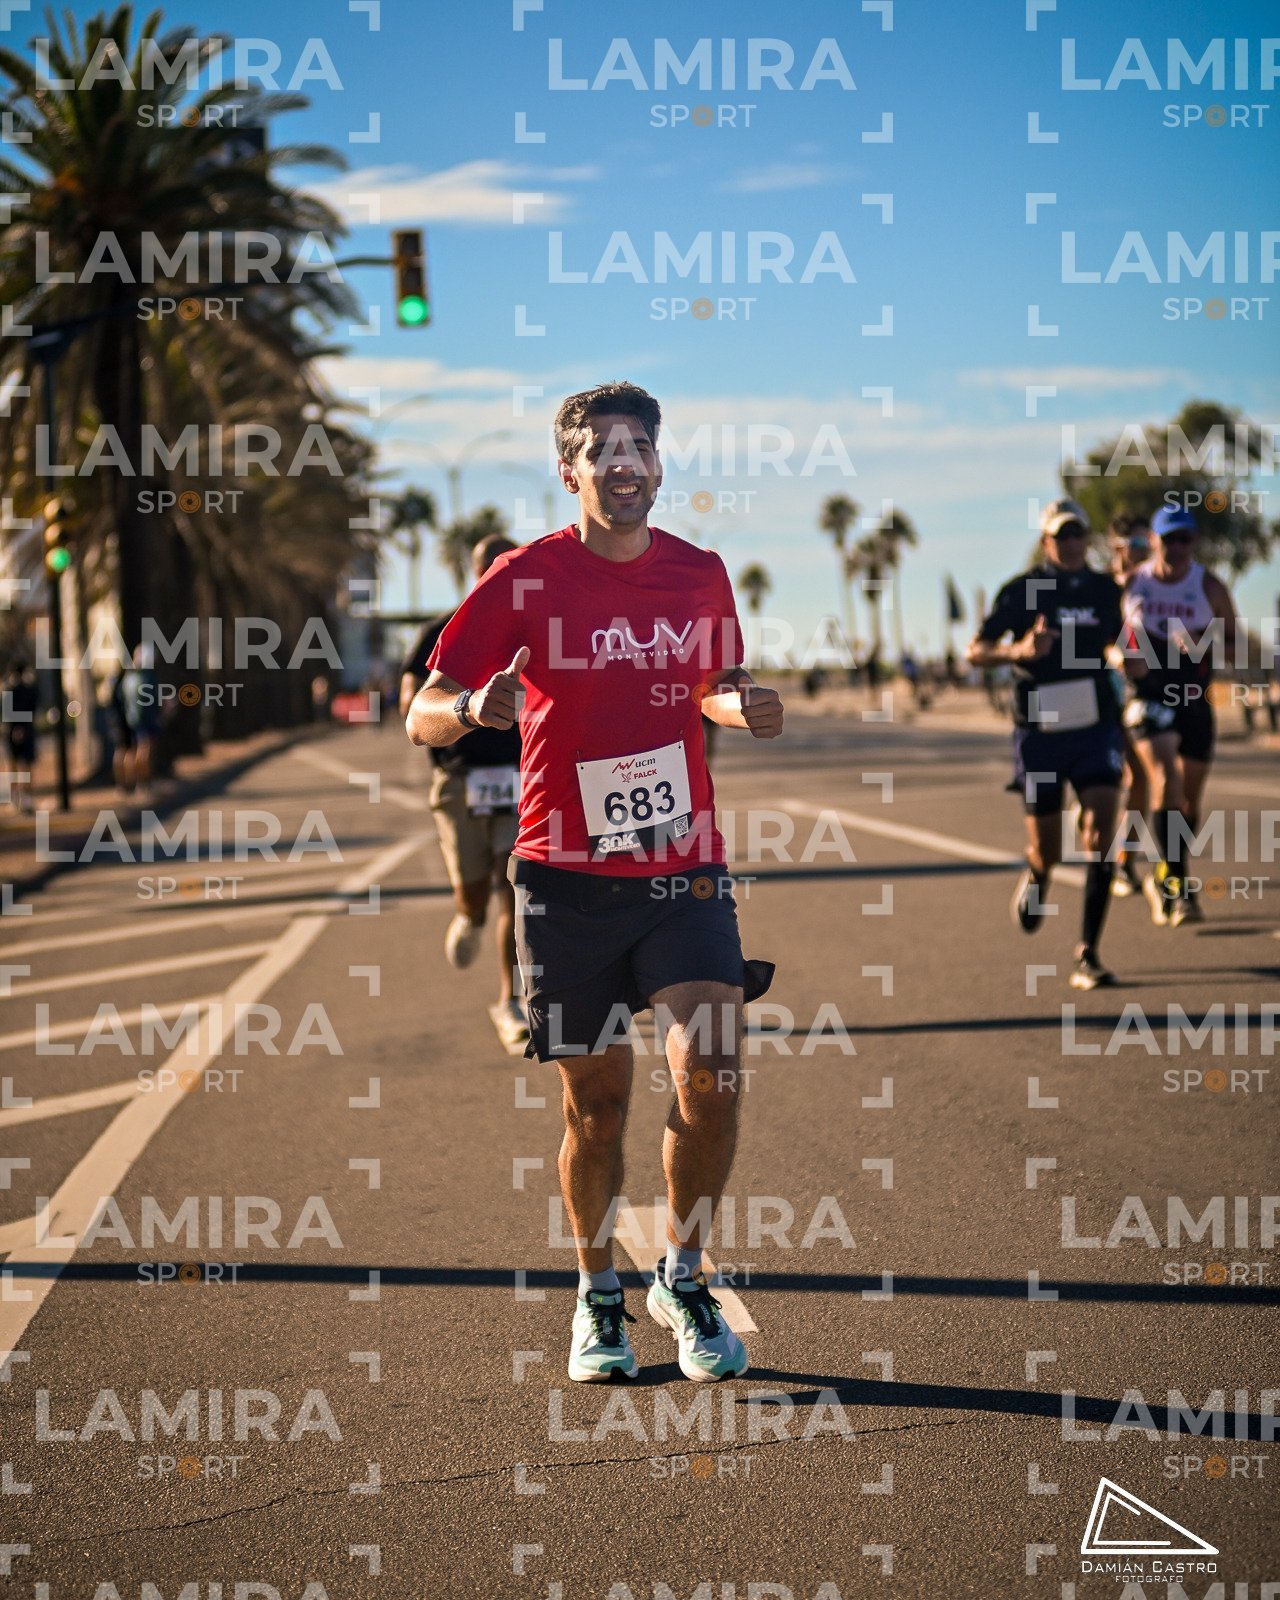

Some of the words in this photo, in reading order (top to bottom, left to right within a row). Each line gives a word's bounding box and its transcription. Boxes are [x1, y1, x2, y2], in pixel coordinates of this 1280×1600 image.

[607, 648, 685, 662] MONTEVIDEO
[635, 757, 656, 768] ucm
[633, 769, 657, 780] FALCK
[604, 781, 675, 826] 683
